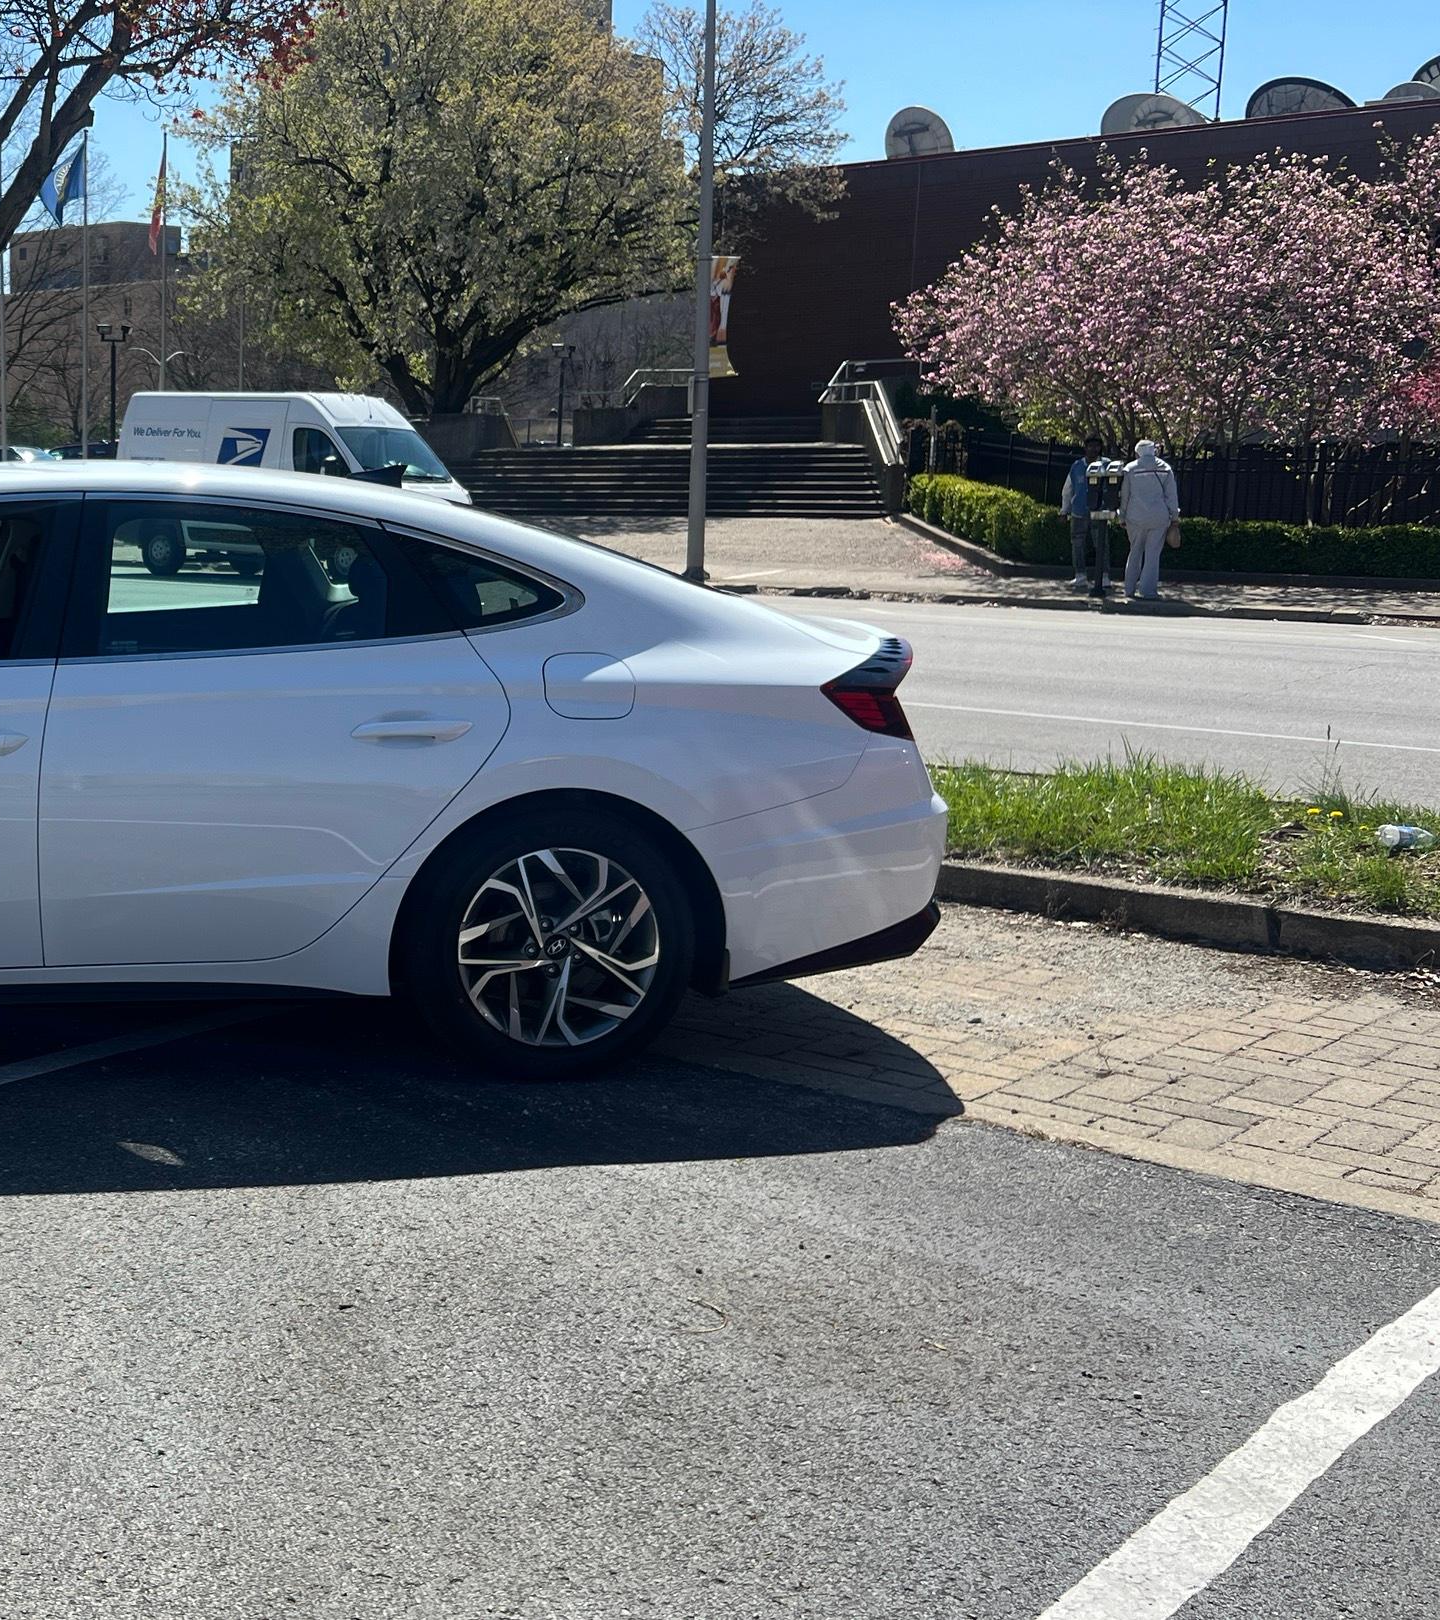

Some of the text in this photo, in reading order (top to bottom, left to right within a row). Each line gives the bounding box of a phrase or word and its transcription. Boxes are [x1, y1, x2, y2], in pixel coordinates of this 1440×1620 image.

[133, 426, 145, 437] We
[145, 427, 172, 437] Deliver
[172, 428, 186, 437] For
